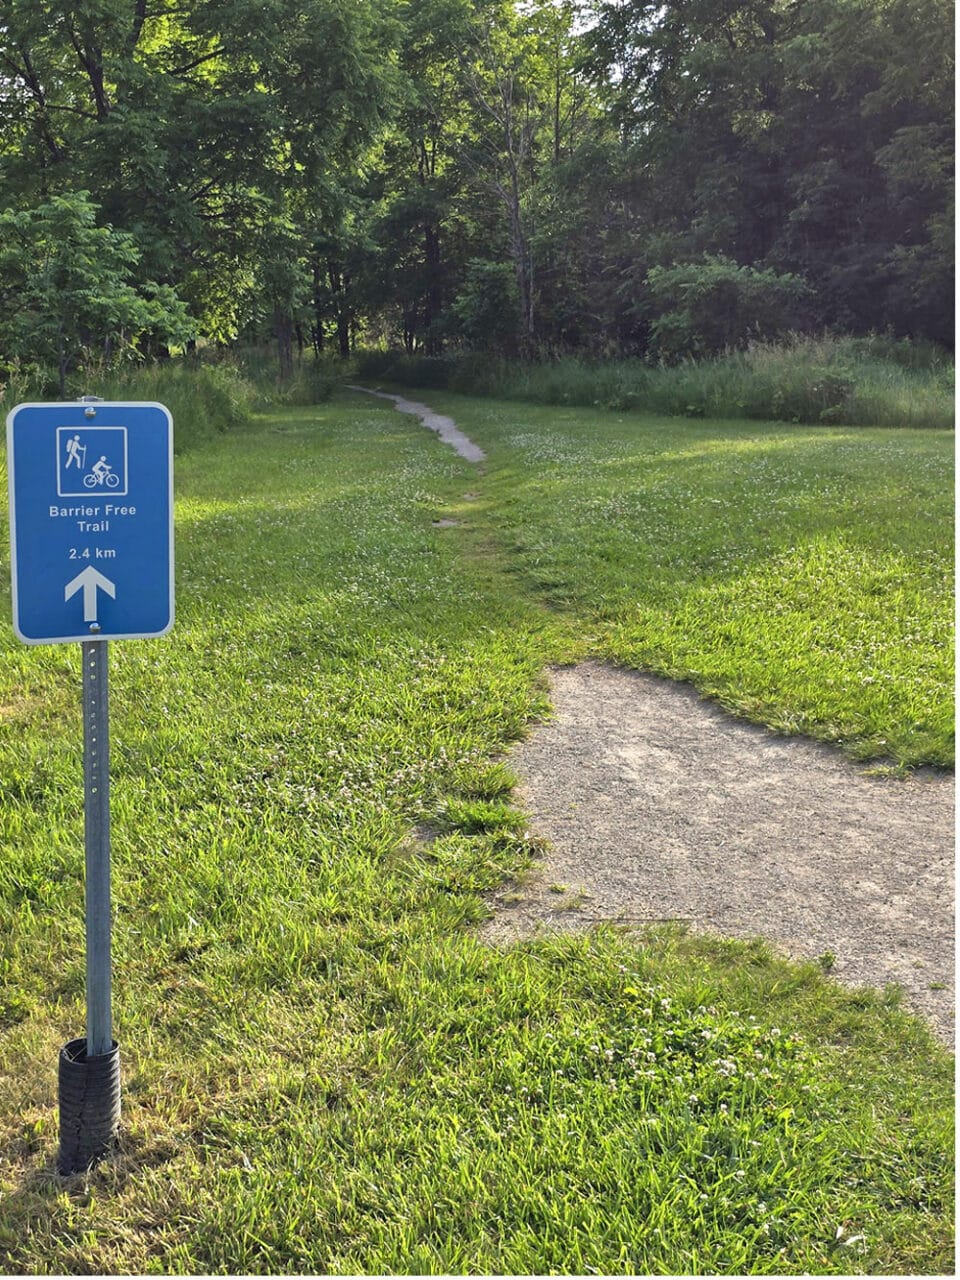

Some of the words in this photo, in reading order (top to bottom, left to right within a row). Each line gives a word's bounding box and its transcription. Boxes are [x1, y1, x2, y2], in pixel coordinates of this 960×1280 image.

[49, 505, 100, 517] Barrier
[105, 504, 136, 516] Free
[77, 520, 109, 532] Trail
[69, 548, 90, 559] 2.4
[95, 547, 116, 558] km
